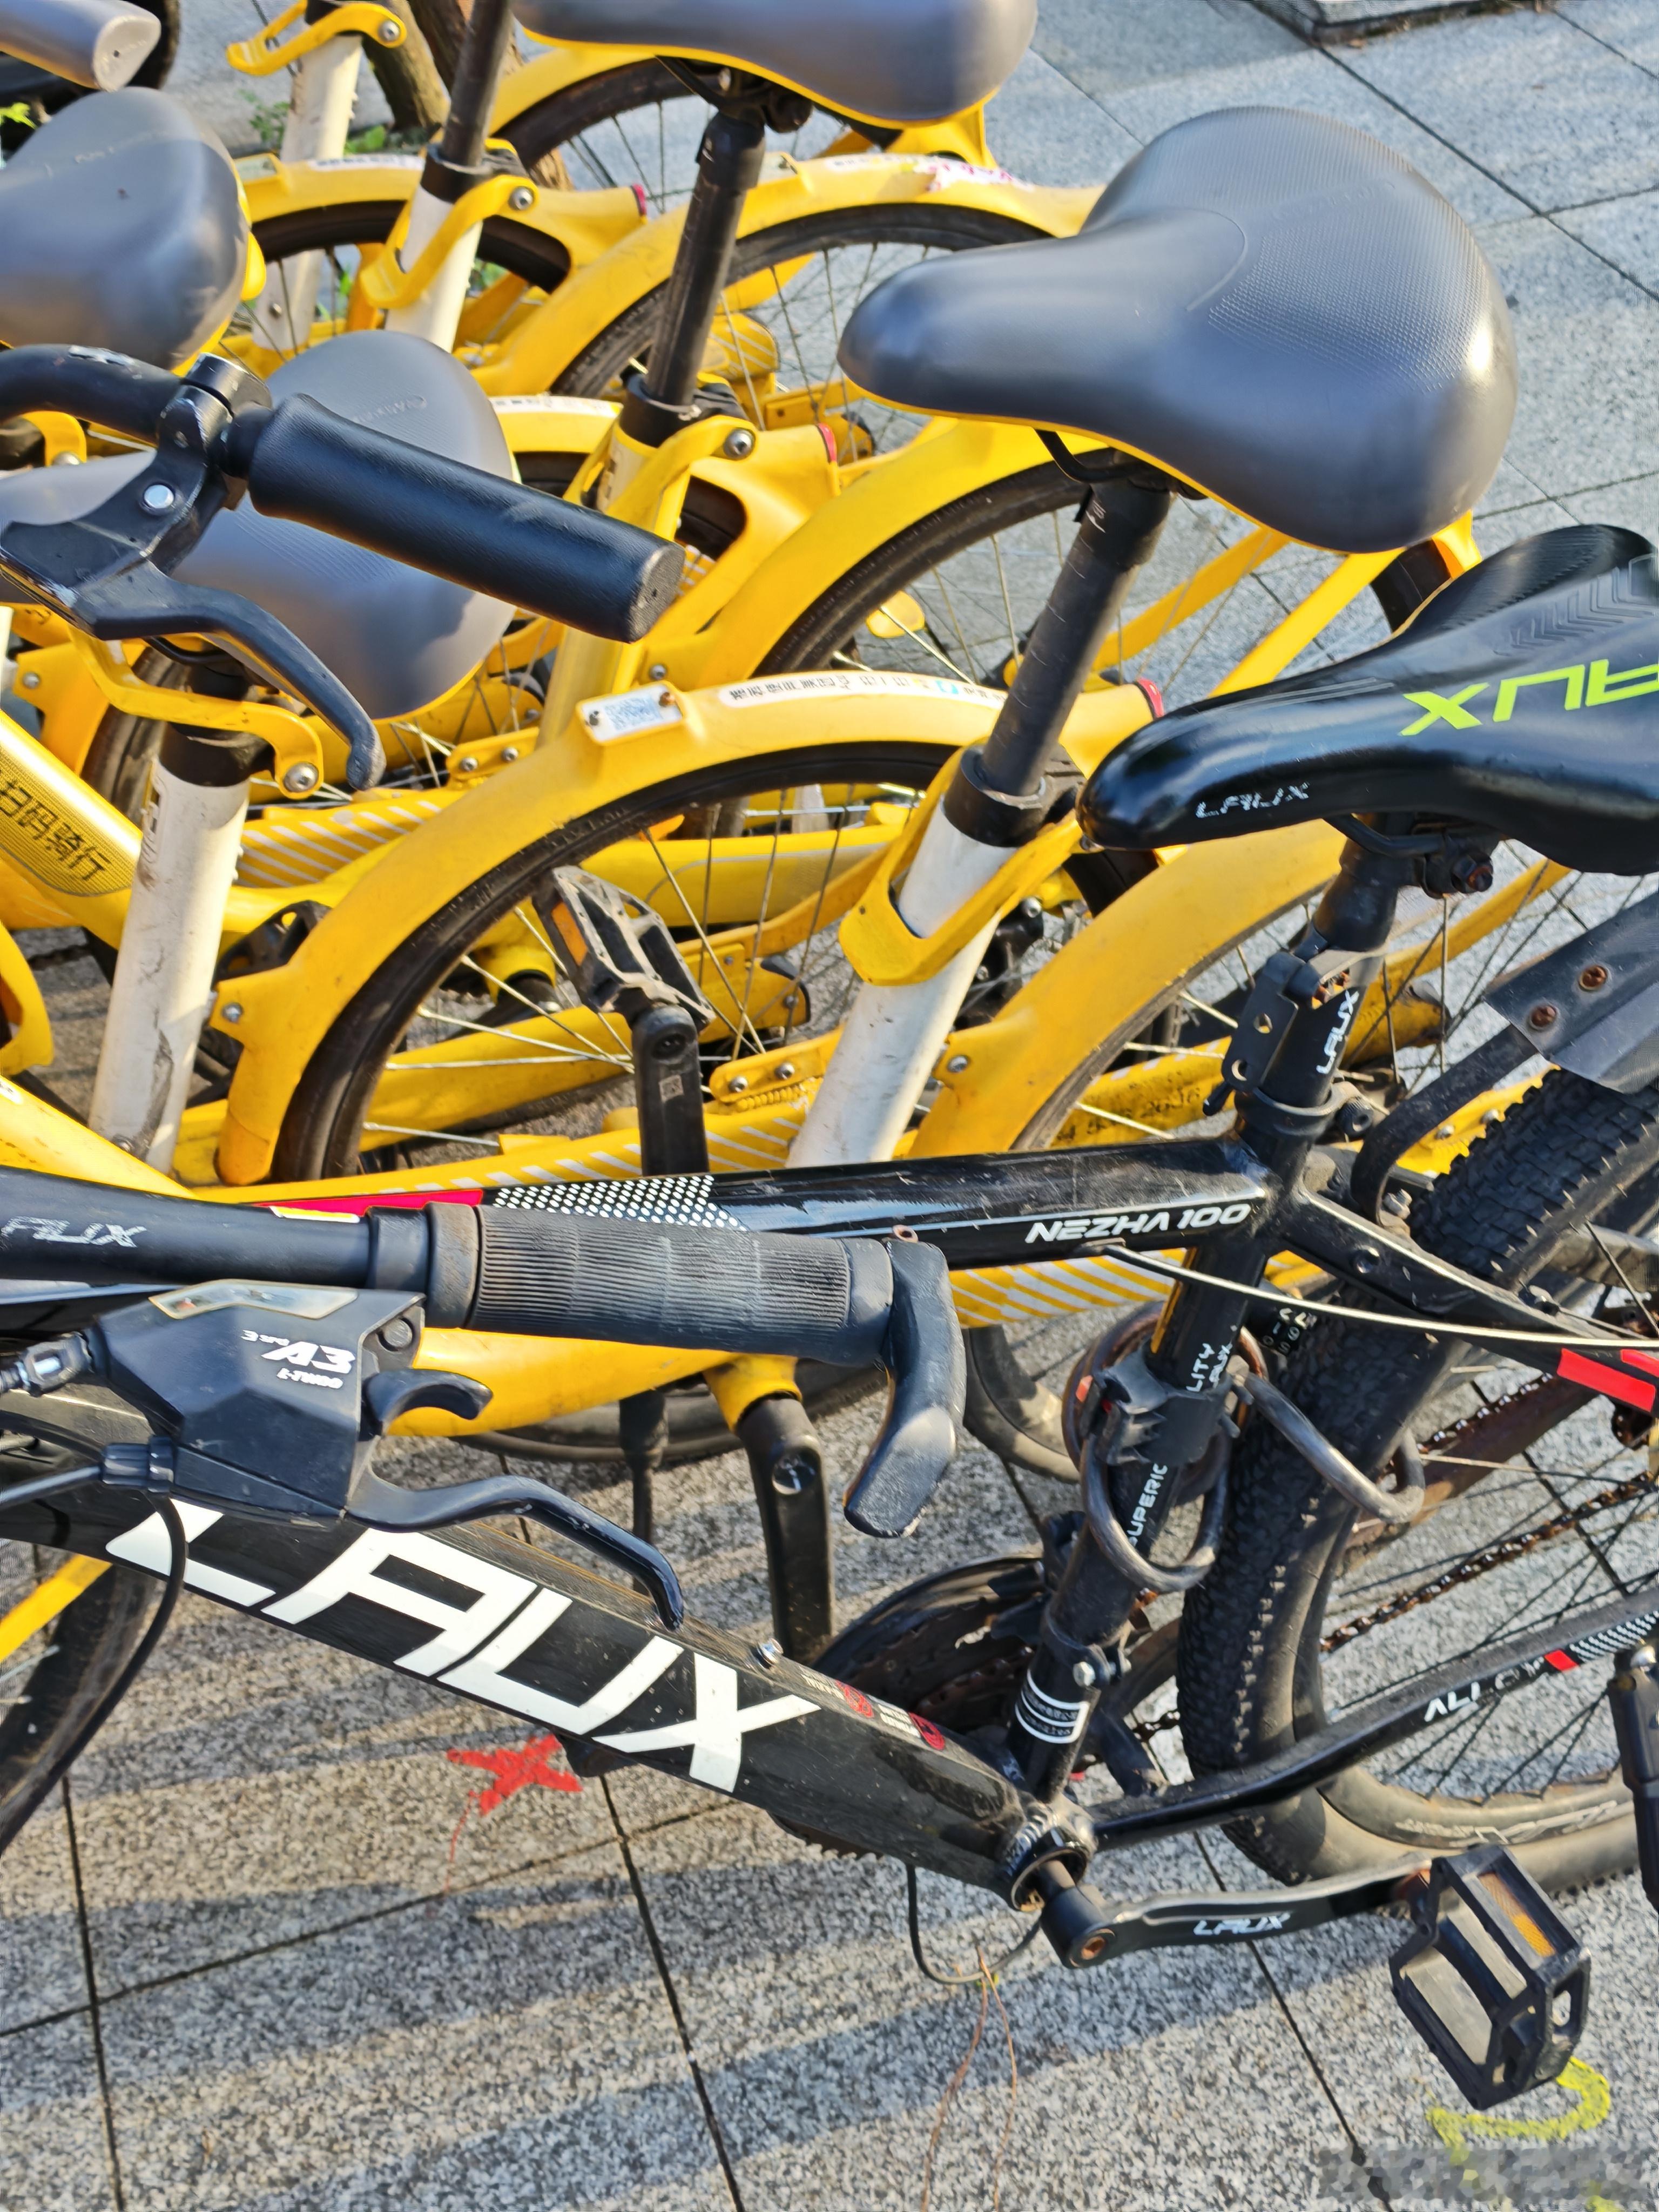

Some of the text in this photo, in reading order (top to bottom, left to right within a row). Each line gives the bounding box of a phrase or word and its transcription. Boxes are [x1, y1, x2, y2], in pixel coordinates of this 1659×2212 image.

[1196, 781, 1311, 819] LAUX
[1316, 988, 1361, 1075] LAUX
[1025, 1203, 1250, 1243] NEZHA 100
[262, 1339, 357, 1375] A3
[106, 1499, 822, 1792] LAUX
[1193, 1912, 1291, 1936] LAUX
